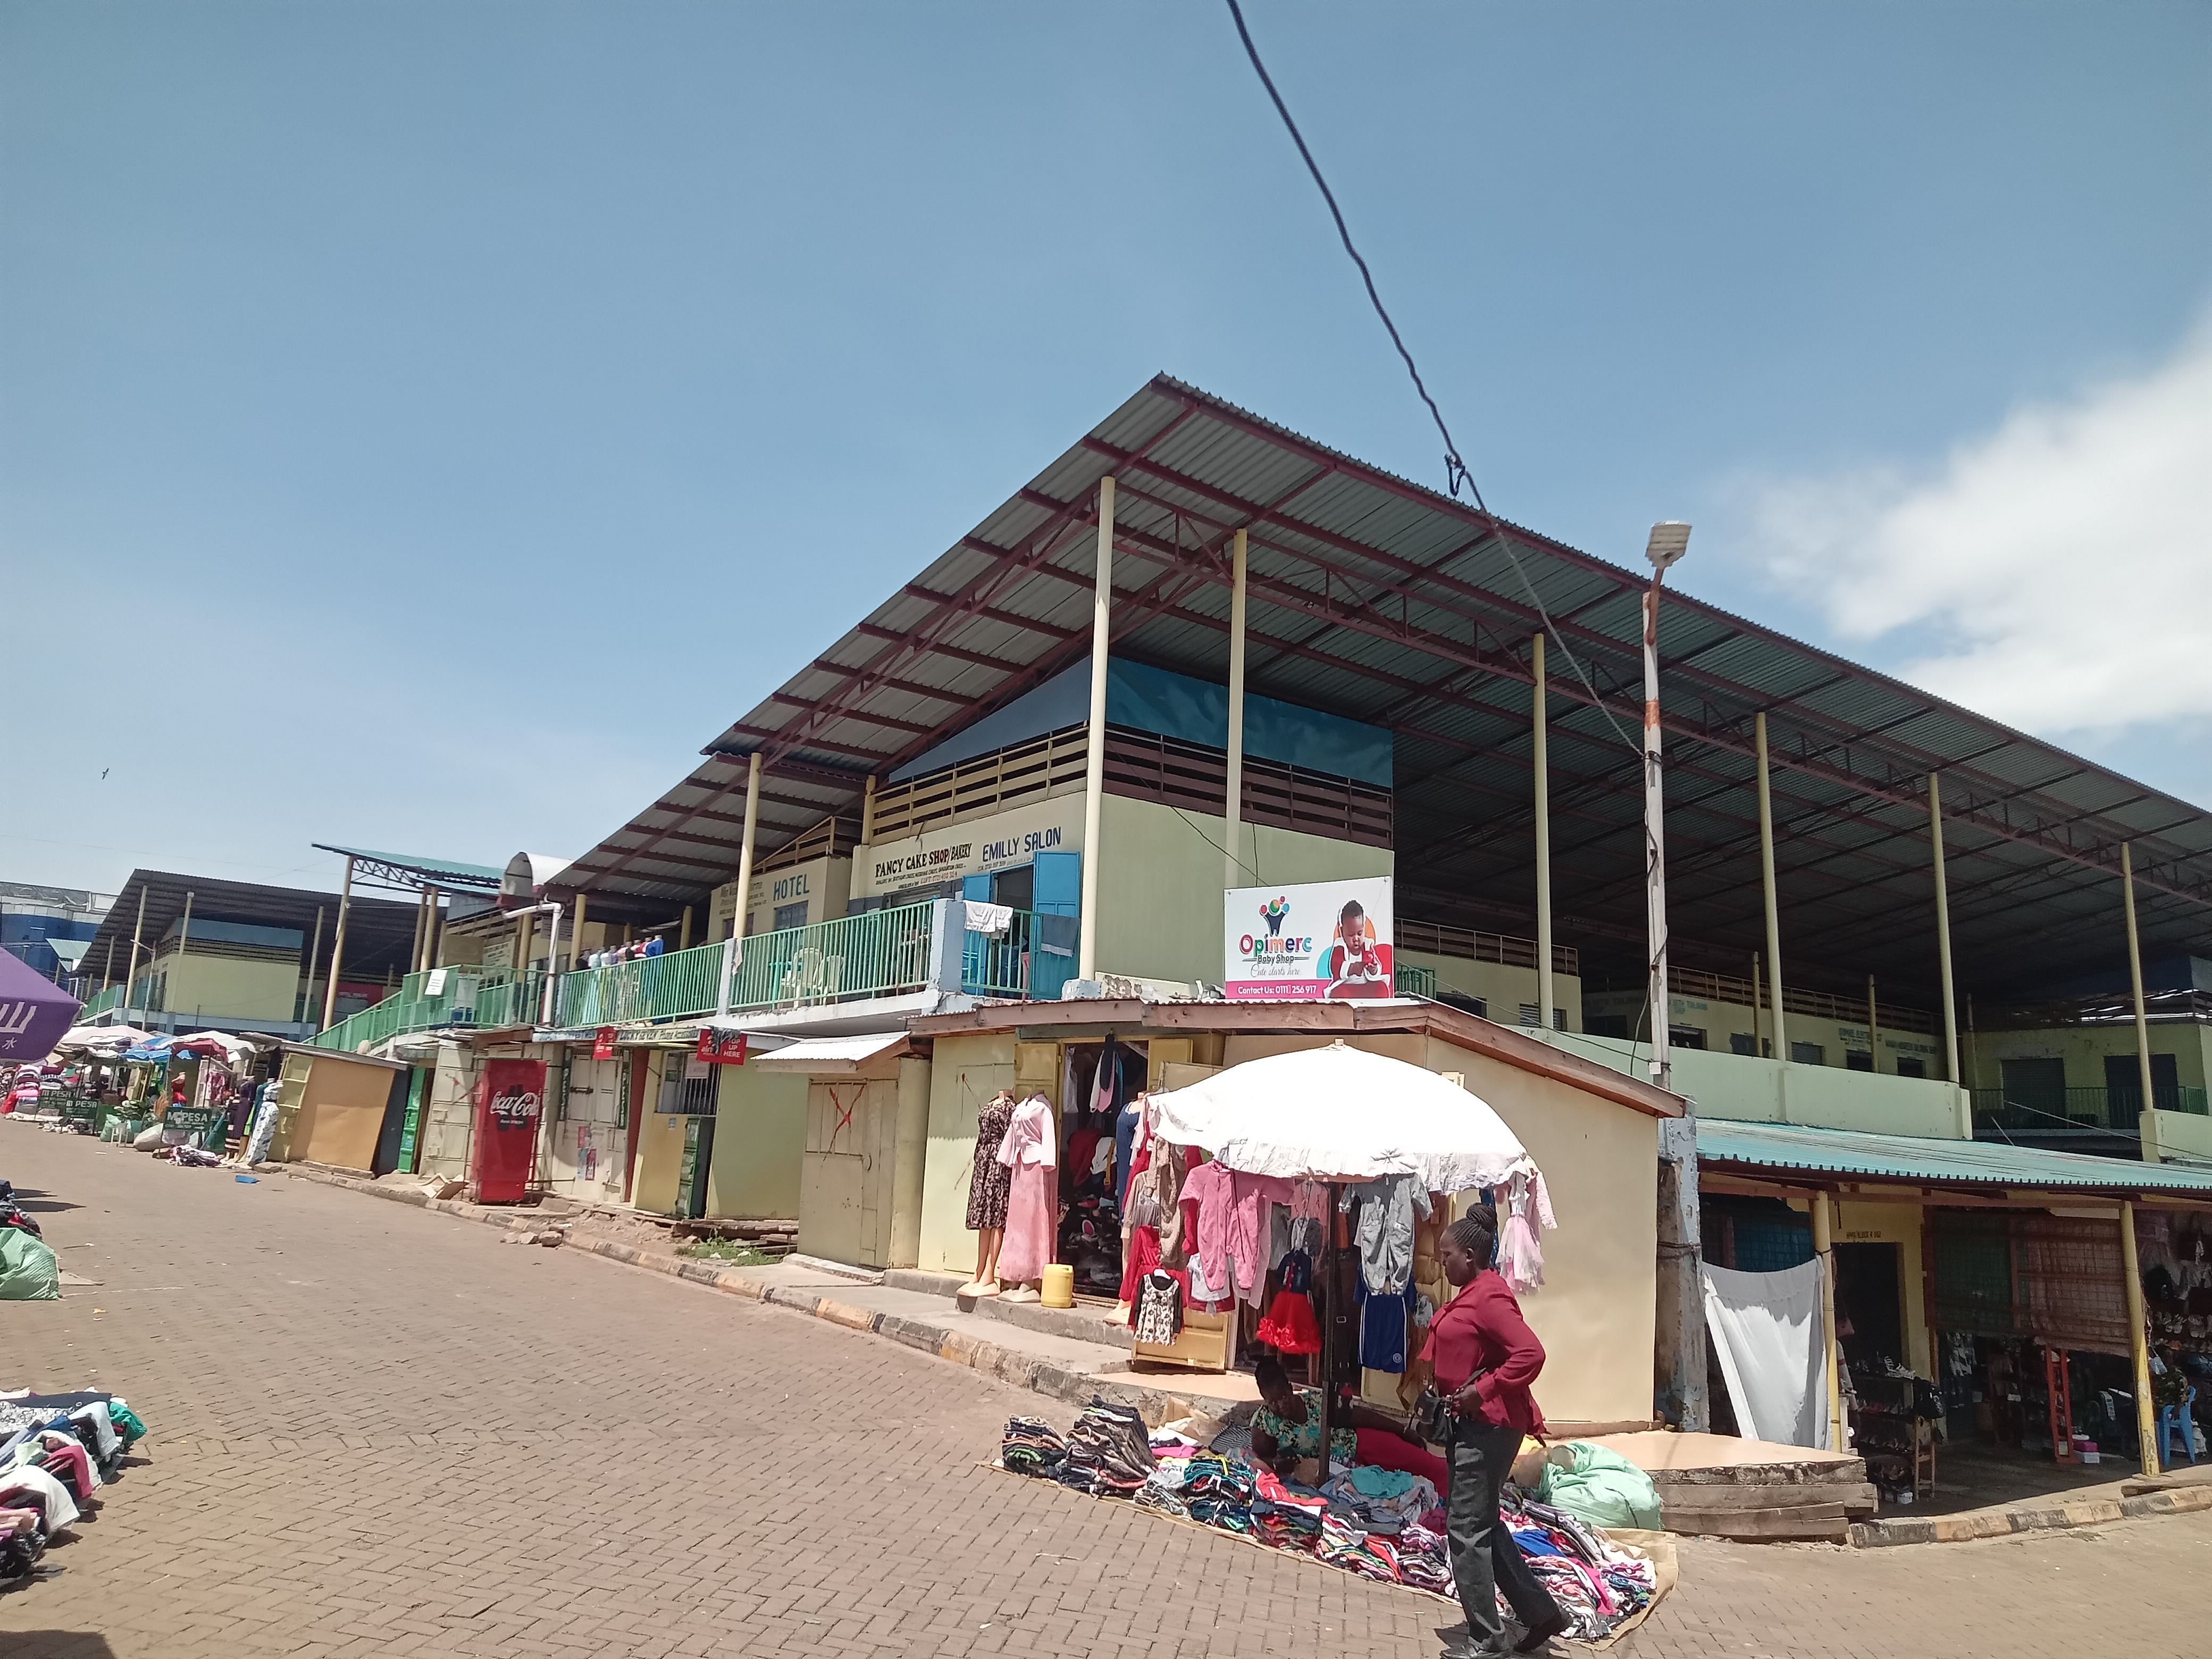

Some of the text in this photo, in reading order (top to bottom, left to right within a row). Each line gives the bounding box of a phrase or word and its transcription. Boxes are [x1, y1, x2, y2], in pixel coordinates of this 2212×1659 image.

[983, 826, 1061, 862] EMILLY SALON
[875, 858, 904, 878] FANCY
[906, 853, 927, 870] CAKE
[773, 874, 810, 901] HOTEL
[1239, 934, 1312, 958] Opimerc
[1258, 954, 1294, 966] Baby Shop
[1250, 963, 1267, 977] Cute
[1268, 965, 1285, 976] starts
[1237, 986, 1263, 994] Contact
[1264, 986, 1275, 994] Us:
[1292, 985, 1304, 994] 256
[1305, 985, 1317, 994] 917
[2, 1037, 18, 1050] 水
